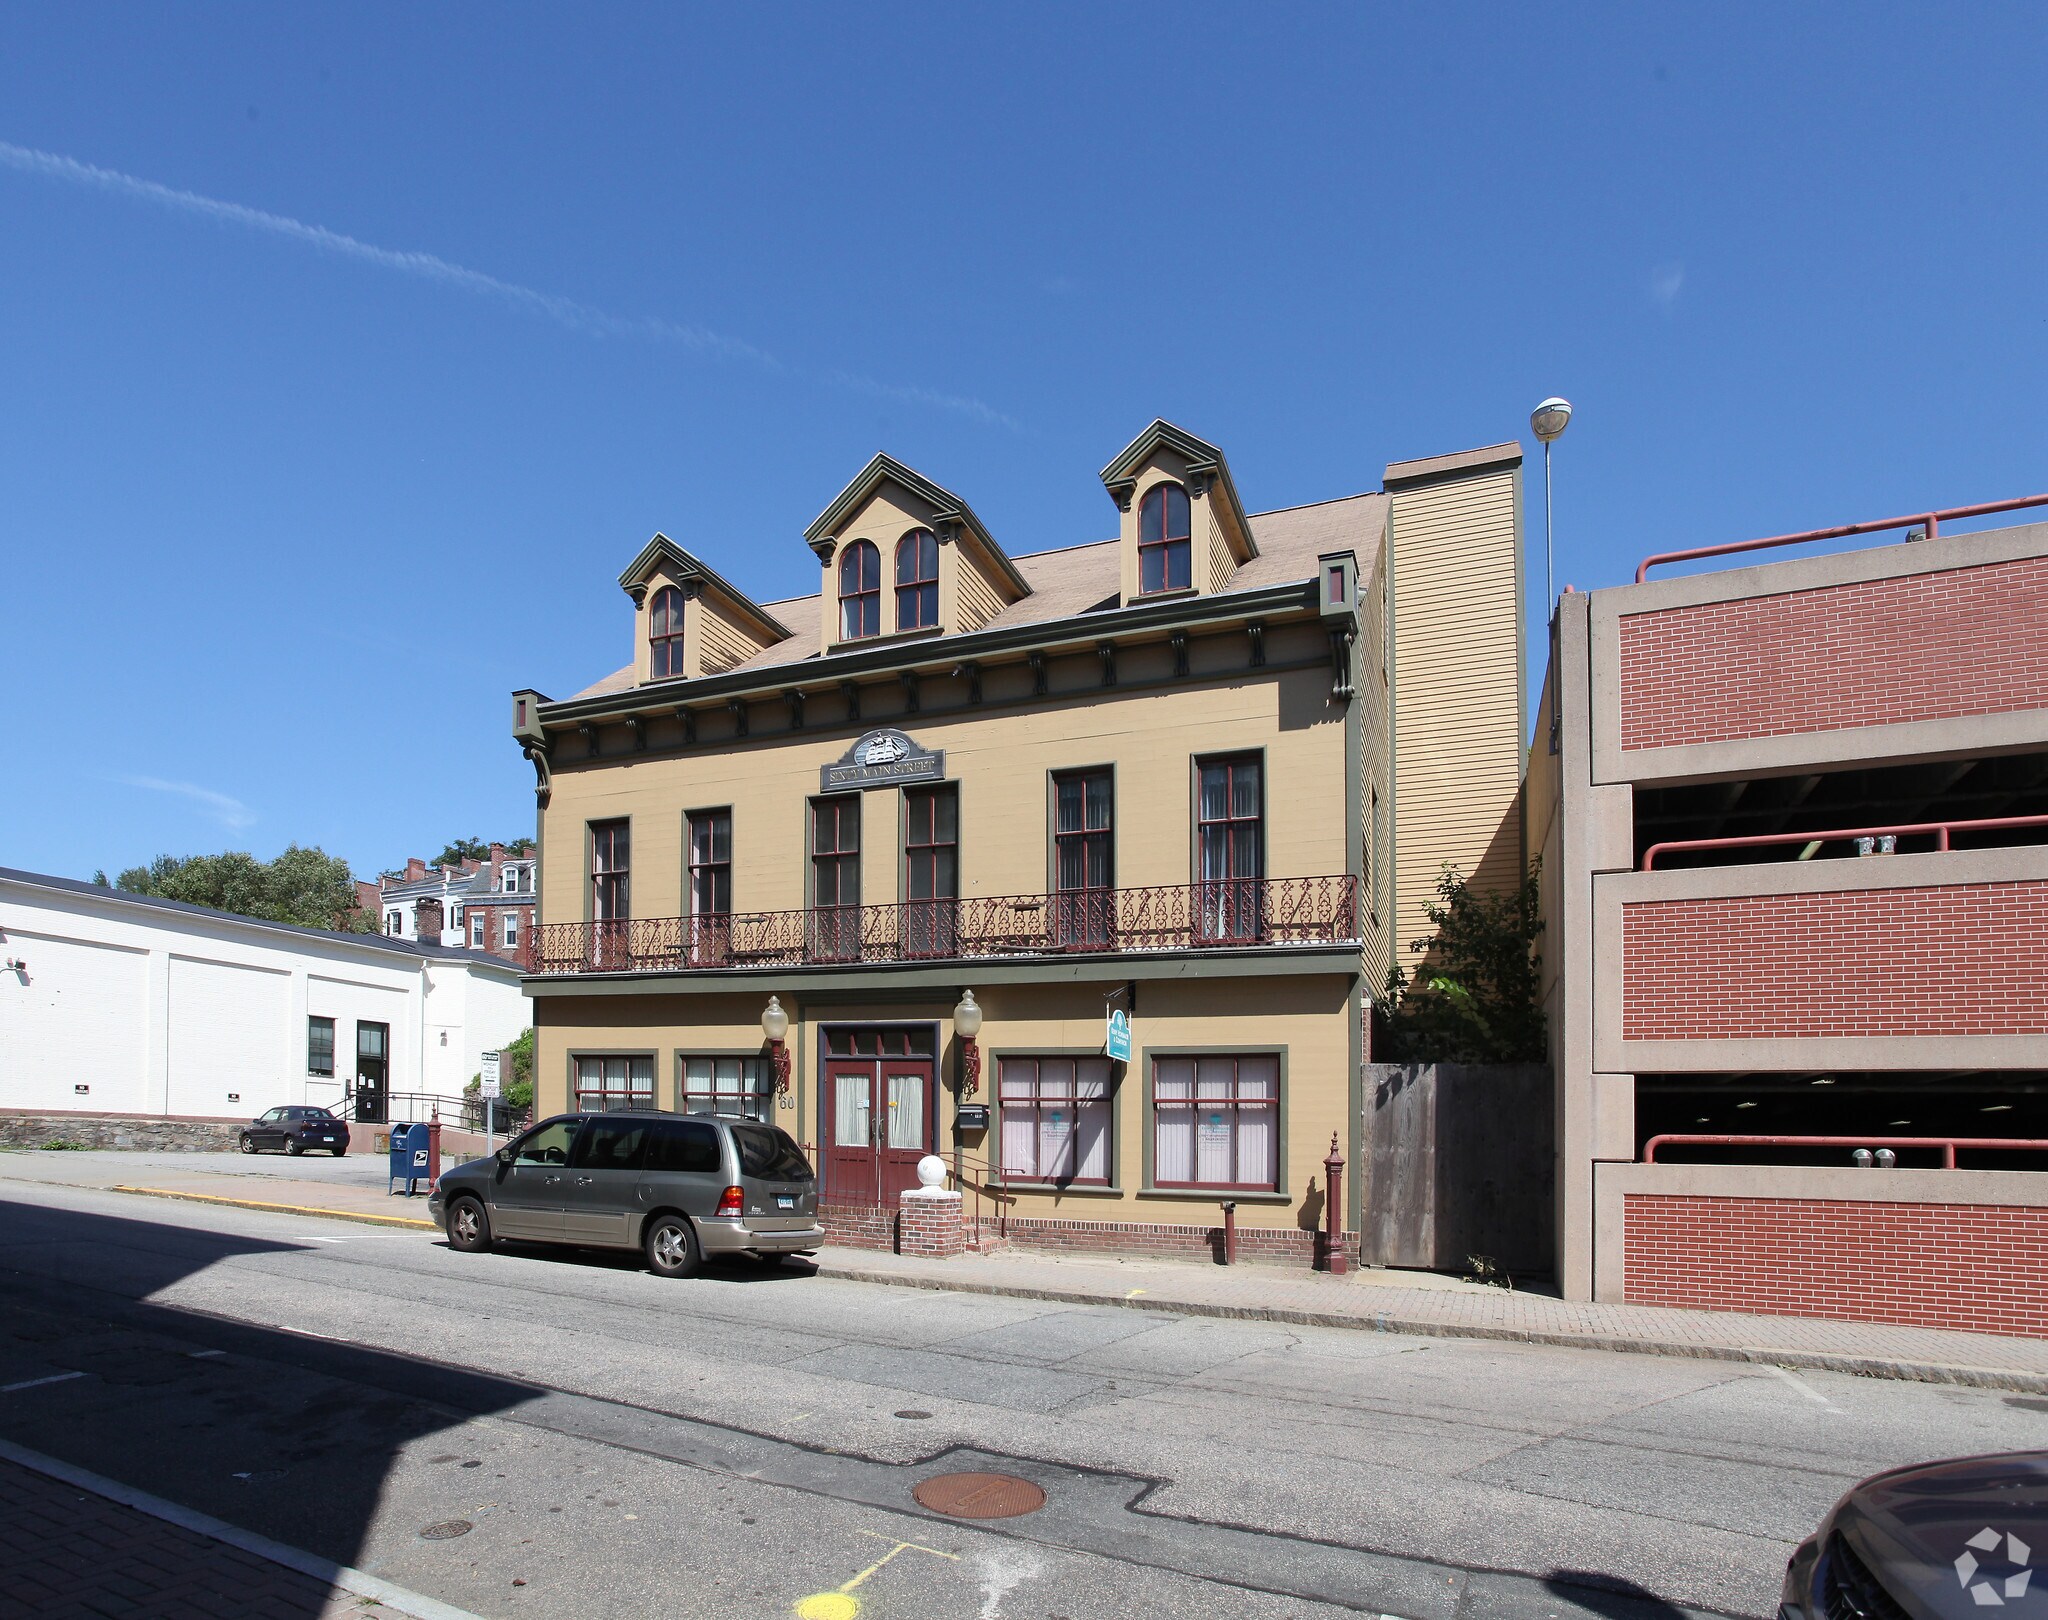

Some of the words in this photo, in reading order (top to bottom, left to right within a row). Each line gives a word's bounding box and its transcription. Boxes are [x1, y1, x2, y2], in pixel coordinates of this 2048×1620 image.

[829, 768, 859, 782] SIXTY
[862, 765, 891, 779] MAIN
[893, 760, 935, 775] STREET
[780, 1096, 794, 1109] 60
